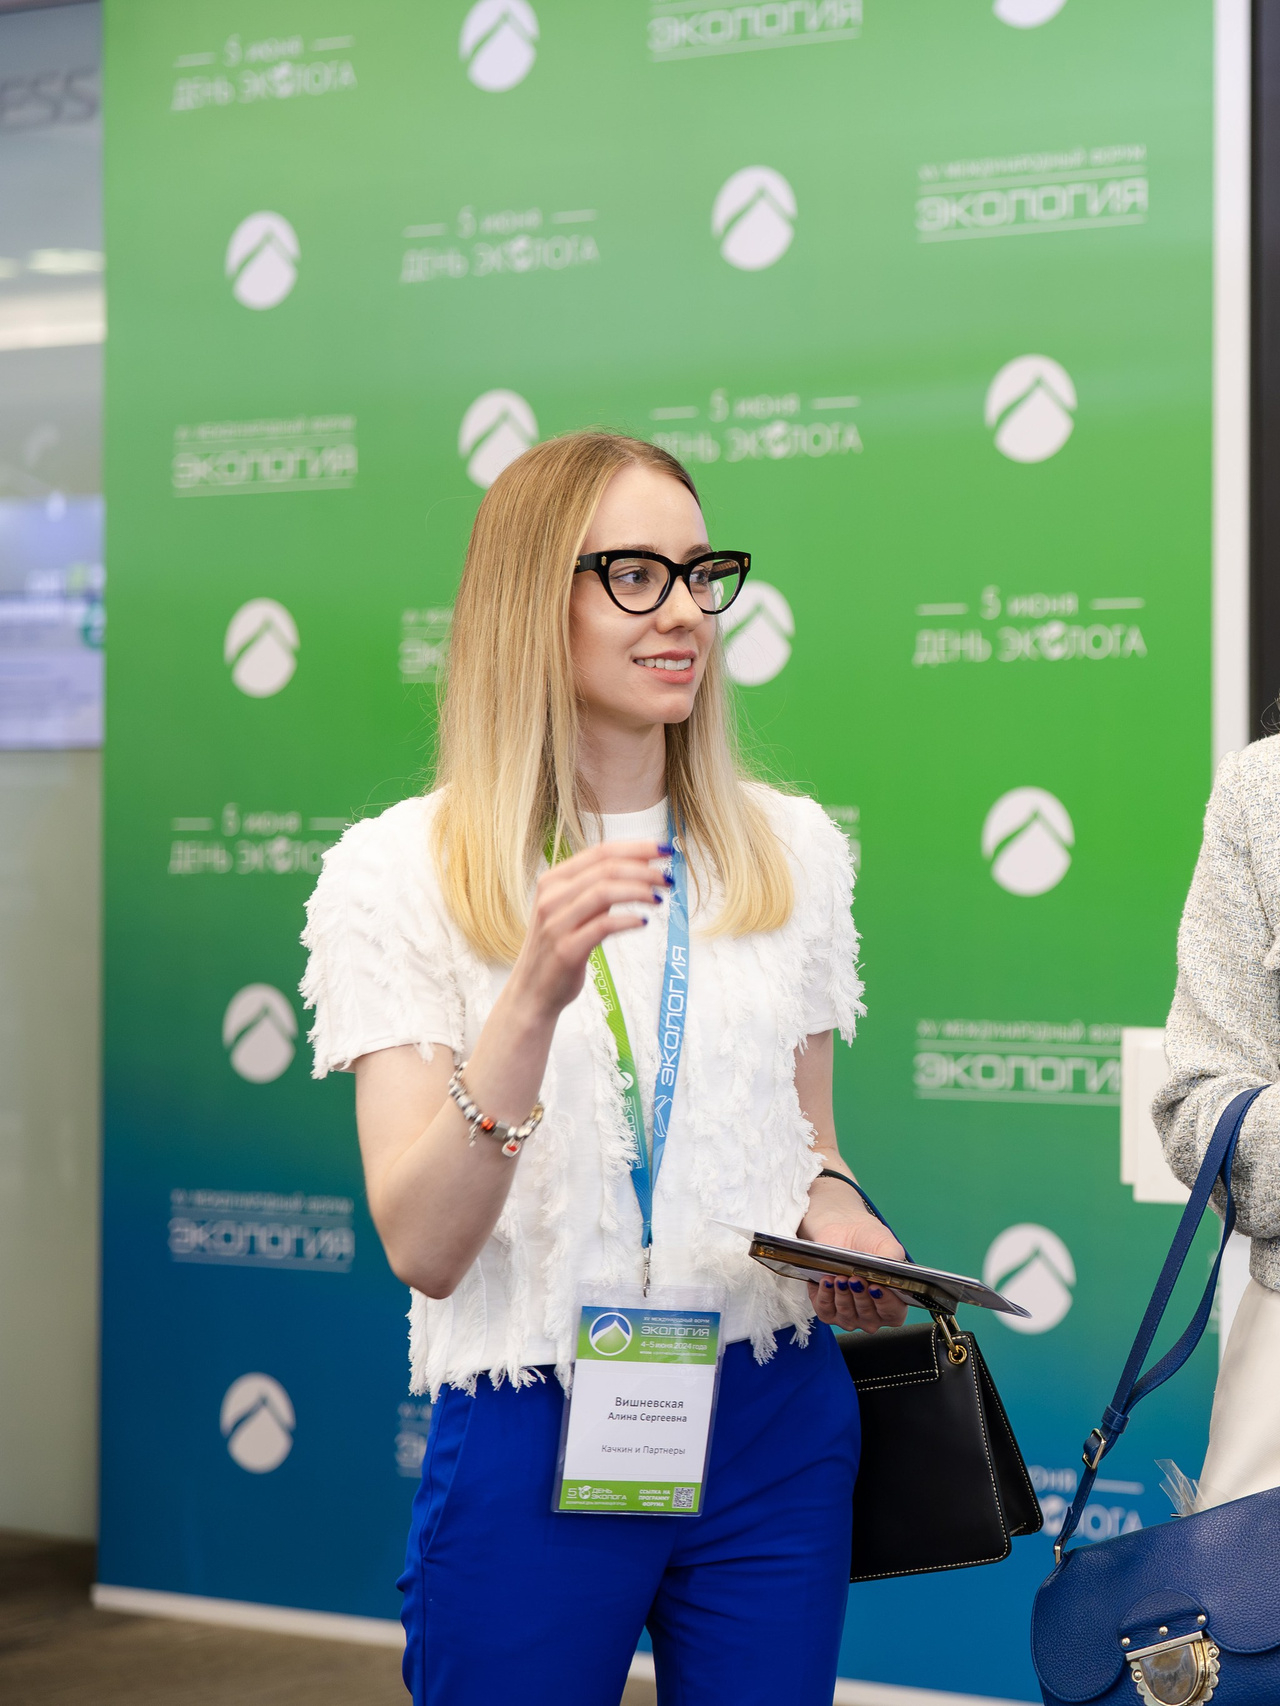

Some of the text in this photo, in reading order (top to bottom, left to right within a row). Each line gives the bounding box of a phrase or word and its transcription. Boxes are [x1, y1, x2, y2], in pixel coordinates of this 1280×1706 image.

[915, 177, 1148, 232] ЭКОЛОГИЯ
[979, 584, 1002, 621] 5
[912, 628, 993, 669] ДЕНЬ
[589, 945, 614, 1012] КОЛОГИЯ
[660, 945, 687, 1087] ЭКОЛОГИЯ
[913, 1052, 1121, 1094] ЭКОЛОГИ
[641, 1325, 710, 1337] ЭКОЛОГИЯ
[673, 1342, 692, 1350] 2024
[615, 1396, 684, 1409] Вишневская
[607, 1412, 688, 1423] Алина Сергеевна
[601, 1445, 633, 1453] Качкин
[642, 1445, 686, 1456] Партнеры
[567, 1487, 577, 1497] 5
